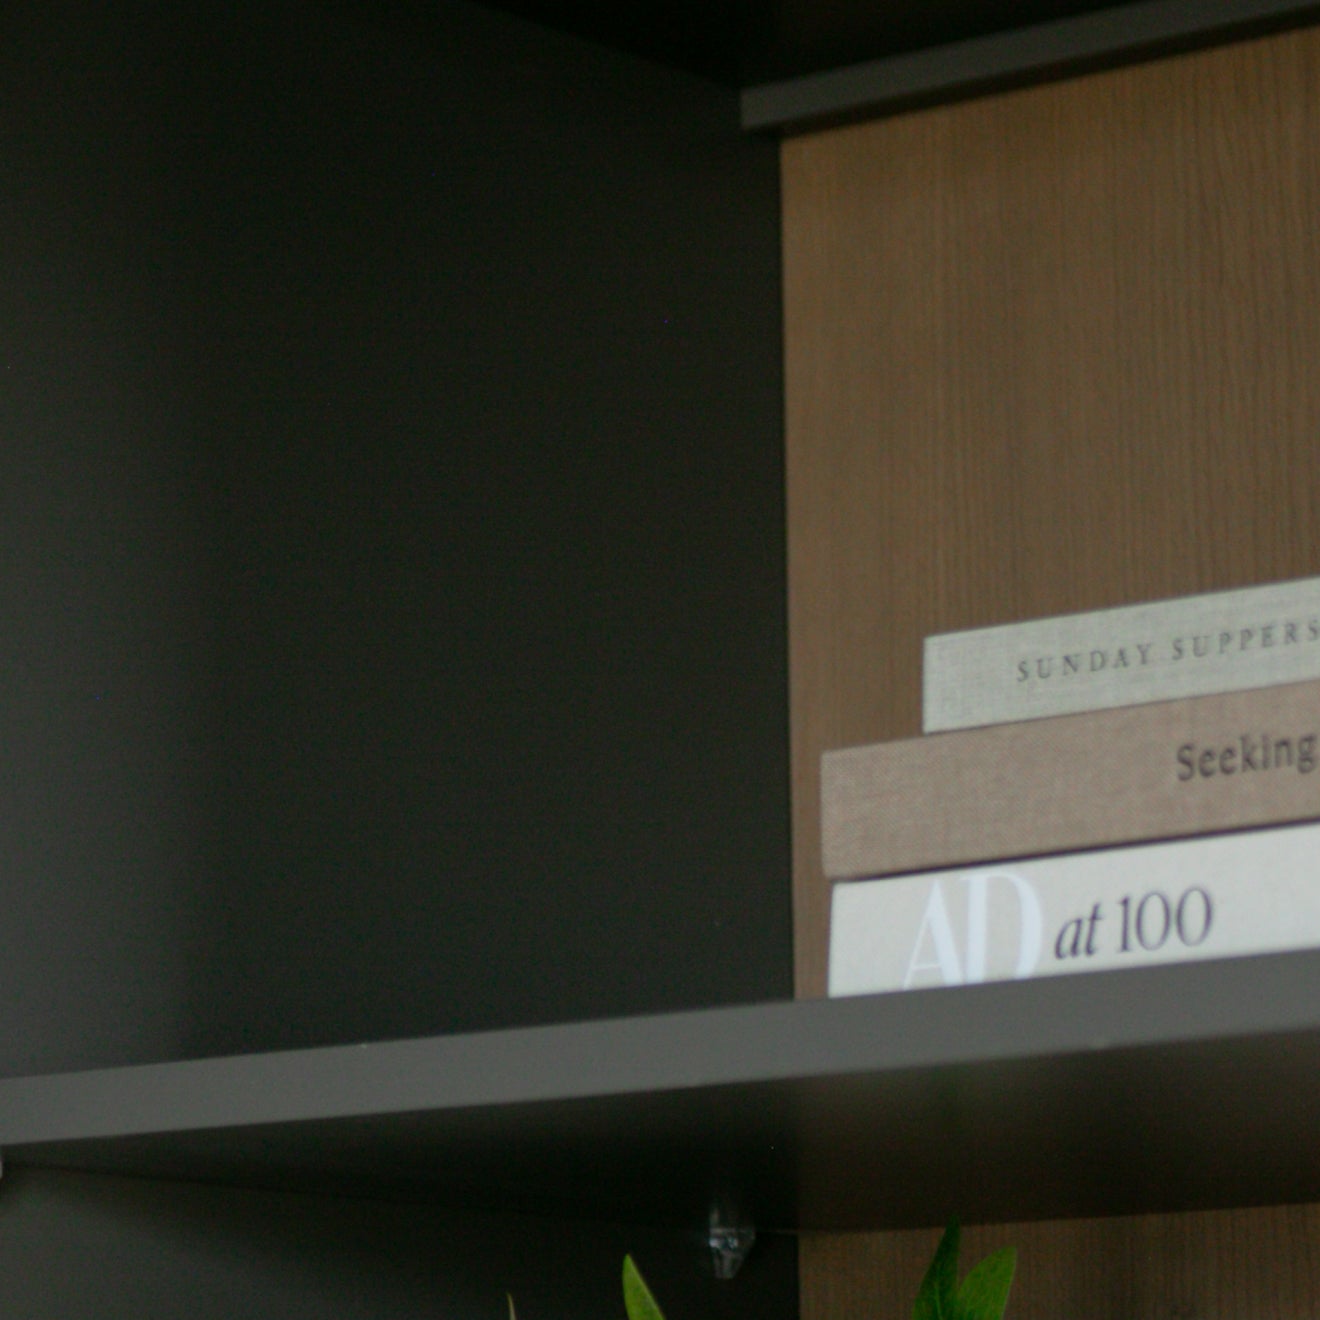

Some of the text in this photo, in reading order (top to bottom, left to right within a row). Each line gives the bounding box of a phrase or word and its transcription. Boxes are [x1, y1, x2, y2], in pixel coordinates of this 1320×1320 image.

[1016, 642, 1152, 683] SUNDAY
[1175, 732, 1318, 782] Seeking
[903, 873, 1214, 990] AD at 100
